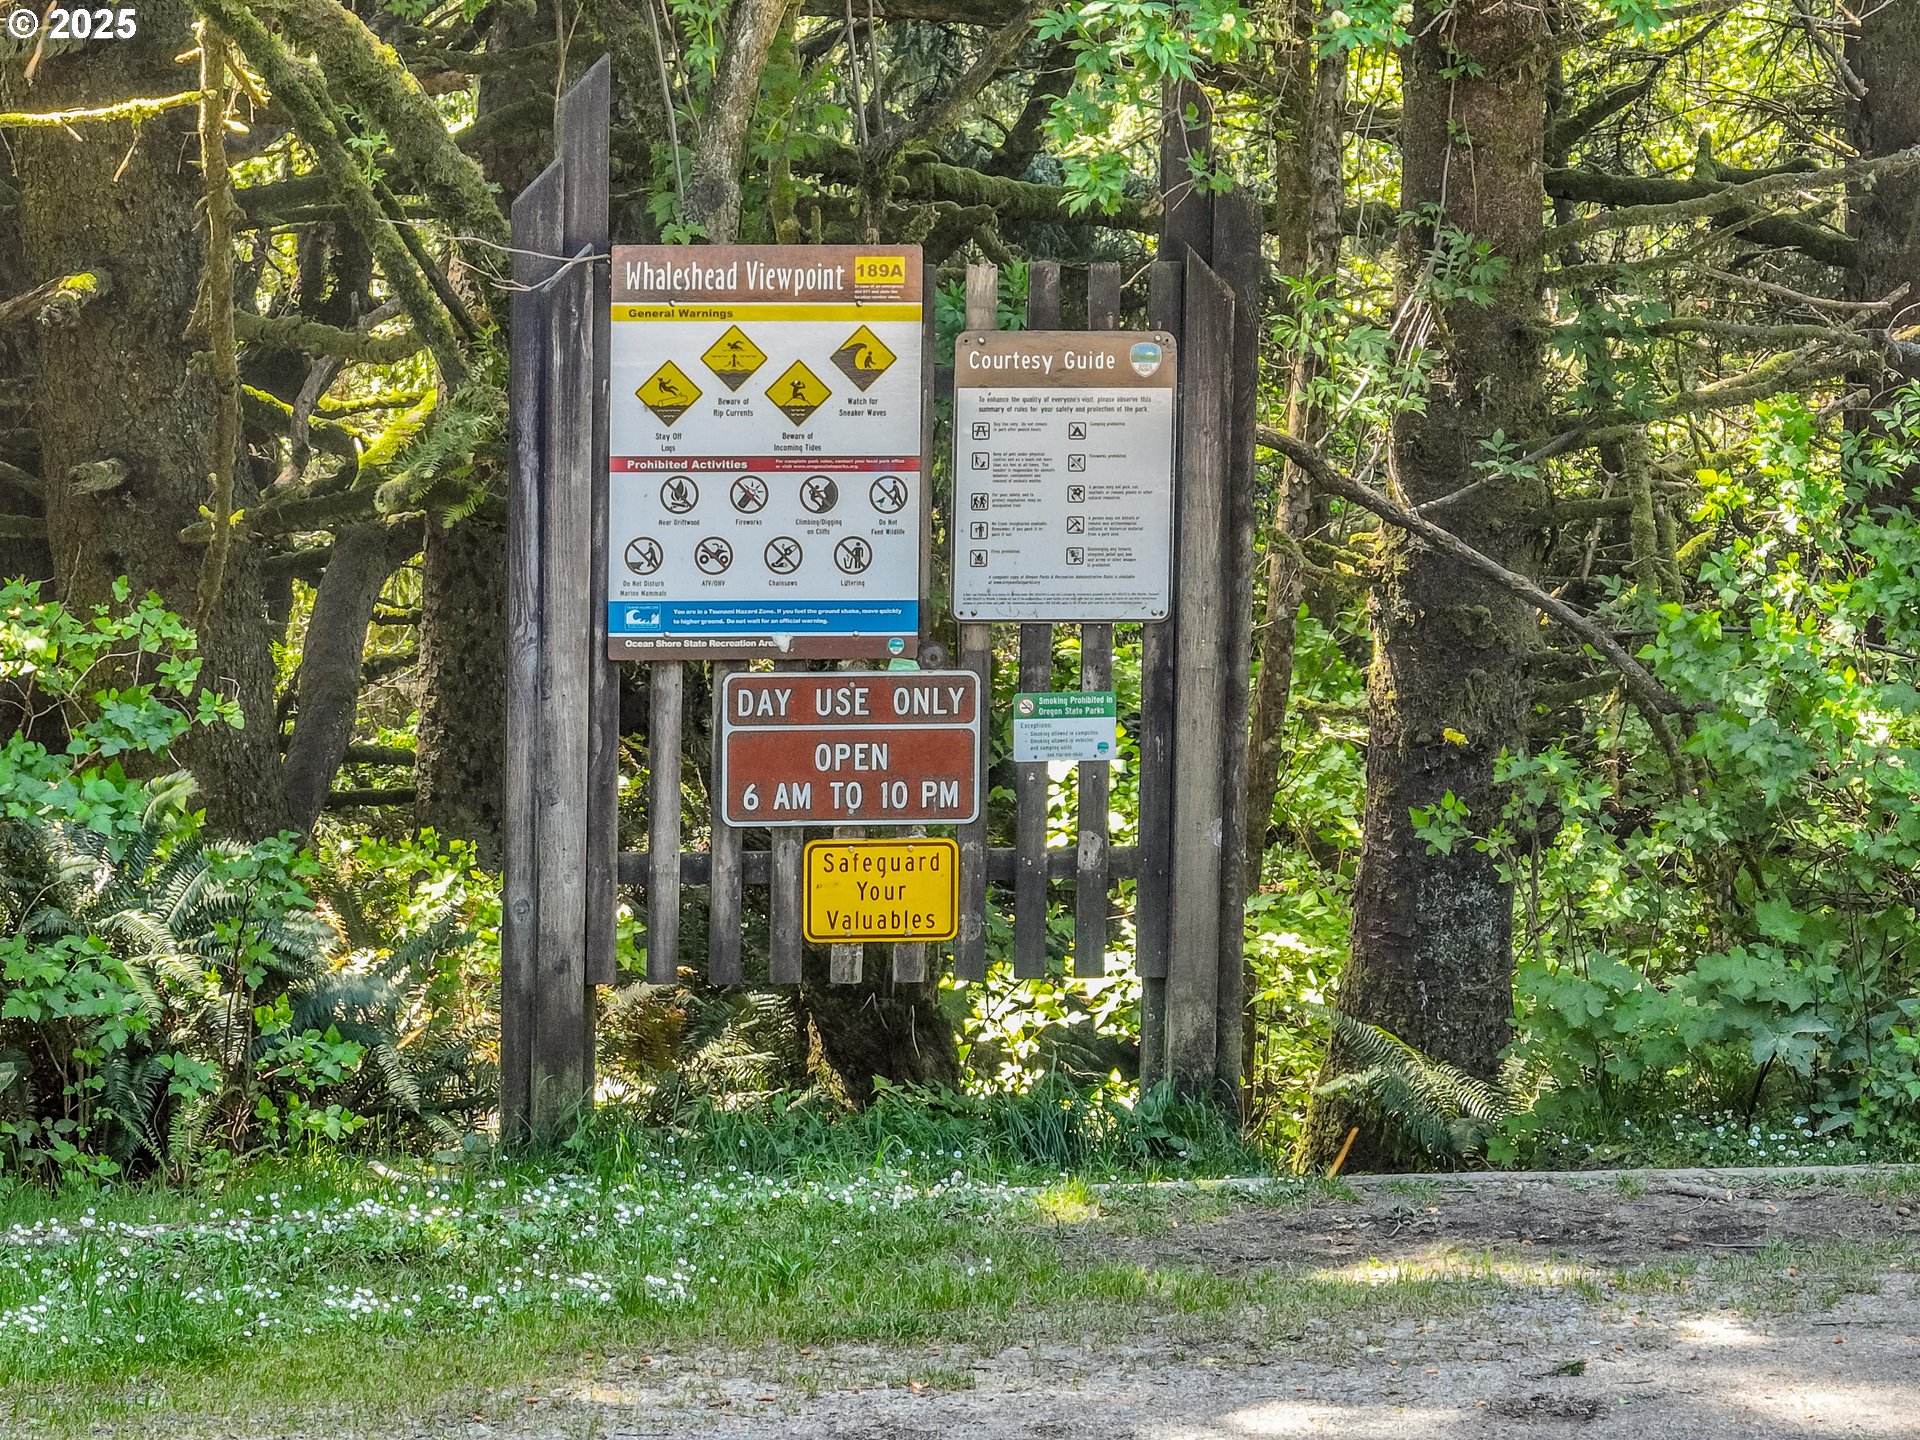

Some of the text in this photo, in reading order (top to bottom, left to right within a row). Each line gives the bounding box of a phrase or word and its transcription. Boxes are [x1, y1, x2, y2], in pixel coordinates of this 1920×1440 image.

[856, 263, 904, 277] 189A
[626, 261, 845, 296] Whaleshead Viewpoint
[628, 308, 733, 320] General Warnings
[969, 351, 1116, 374] Courtesy Guide
[713, 409, 724, 418] Rip
[655, 432, 670, 442] Stay
[661, 444, 676, 453] Logs
[774, 444, 803, 453] Incoming
[627, 460, 748, 470] Prohibited Activities
[840, 580, 865, 588] Littering
[625, 640, 654, 648] Ocean
[656, 640, 682, 648] Shore
[683, 640, 707, 648] State
[709, 640, 756, 648] Recreation
[737, 687, 965, 716] DAY USE ONLY
[1038, 697, 1068, 706] Smoking
[1038, 708, 1062, 717] Oregon
[1085, 706, 1105, 714] Parks
[814, 743, 888, 772] OPEN
[742, 780, 959, 812] 6 AM TO 10 PM
[822, 853, 940, 878] Safeguard
[856, 882, 906, 901] Your
[826, 909, 936, 930] Valuables
